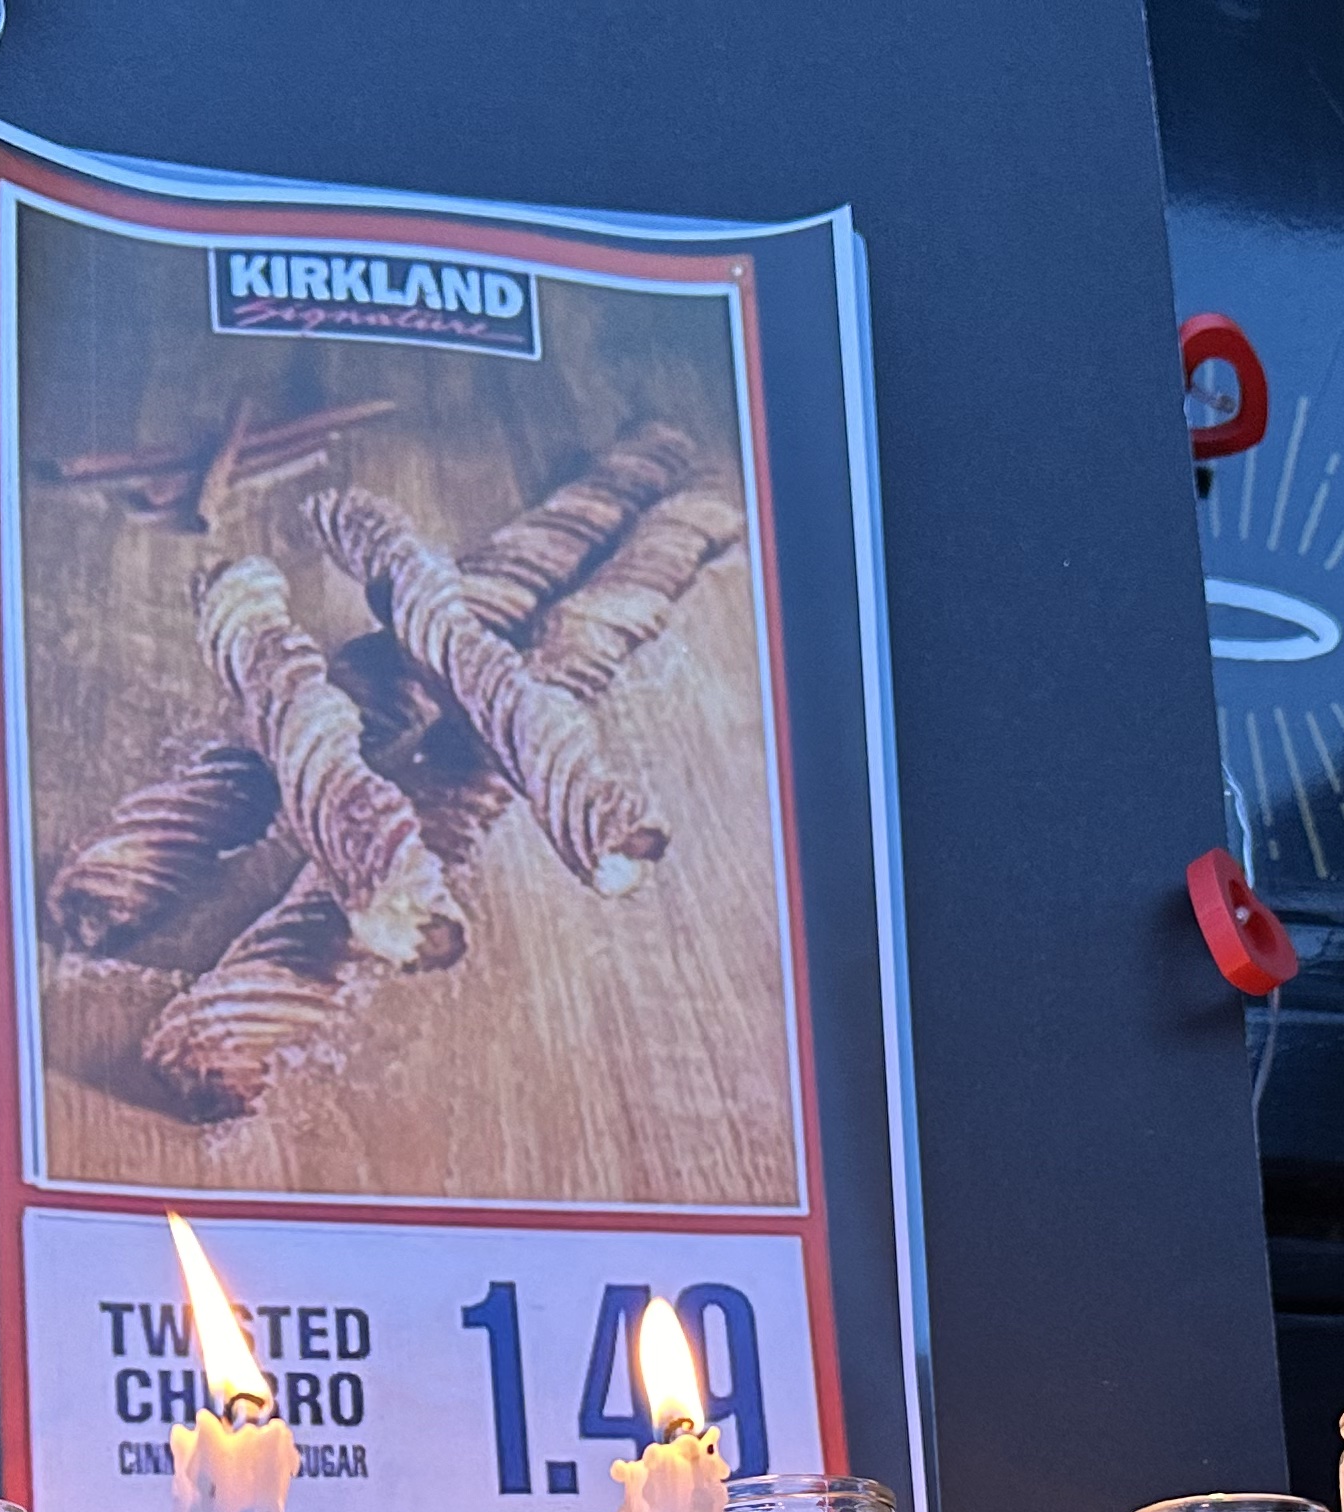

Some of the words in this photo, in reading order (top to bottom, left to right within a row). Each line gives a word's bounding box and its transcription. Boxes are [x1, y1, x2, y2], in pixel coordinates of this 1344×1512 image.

[230, 254, 524, 319] KIRKLAND
[233, 300, 524, 342] Signature
[462, 1281, 770, 1495] 1.49
